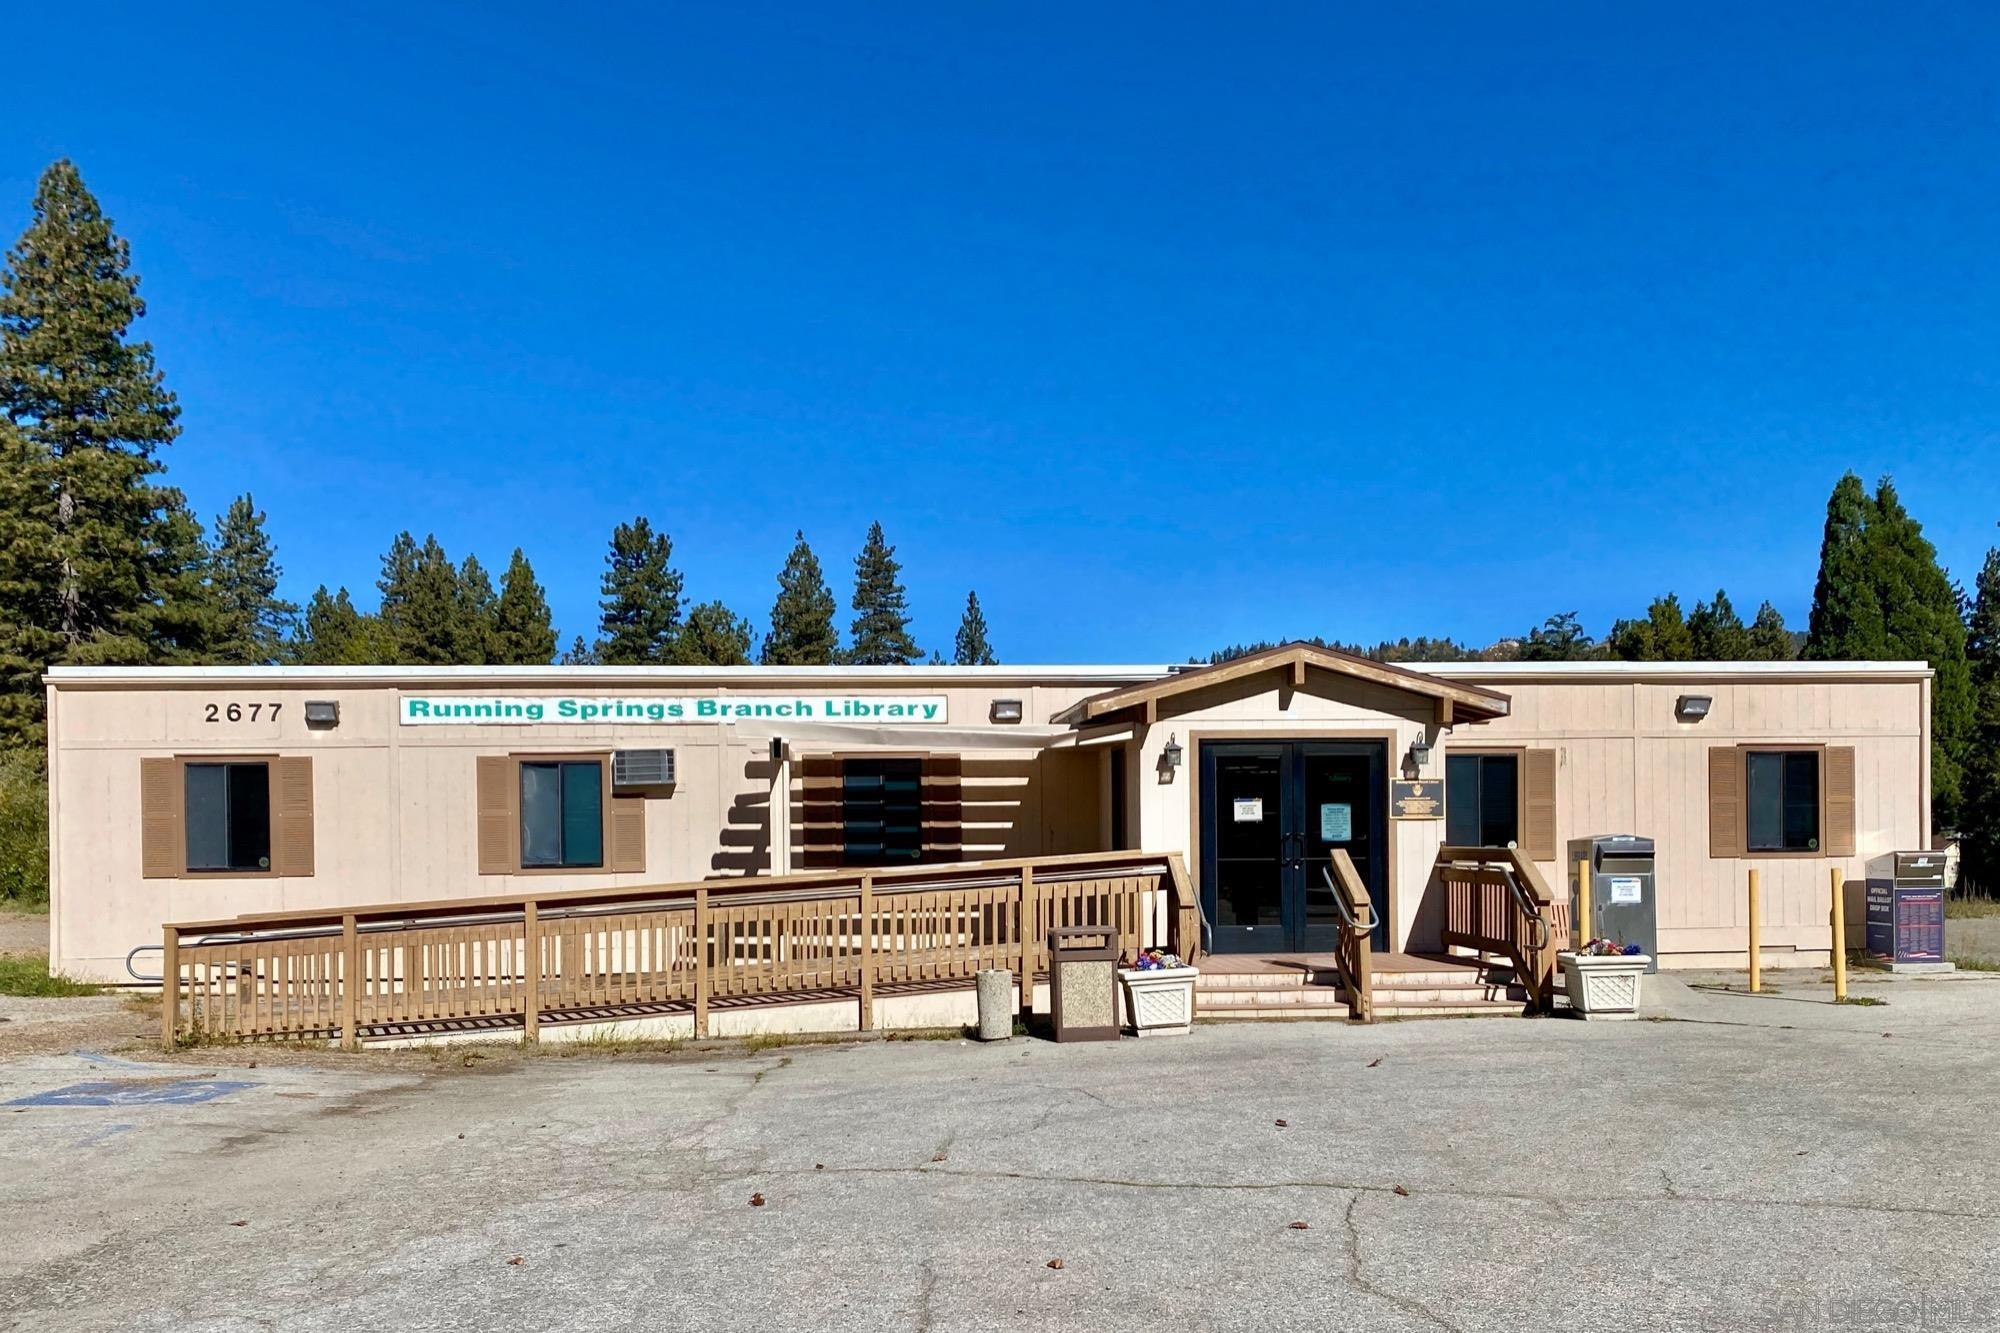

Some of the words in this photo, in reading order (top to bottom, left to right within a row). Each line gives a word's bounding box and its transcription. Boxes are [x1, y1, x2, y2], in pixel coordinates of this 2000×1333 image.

[204, 702, 283, 722] 2677
[408, 699, 544, 720] Running
[557, 699, 684, 720] Springs
[696, 699, 813, 717] Branch
[825, 699, 939, 719] Library
